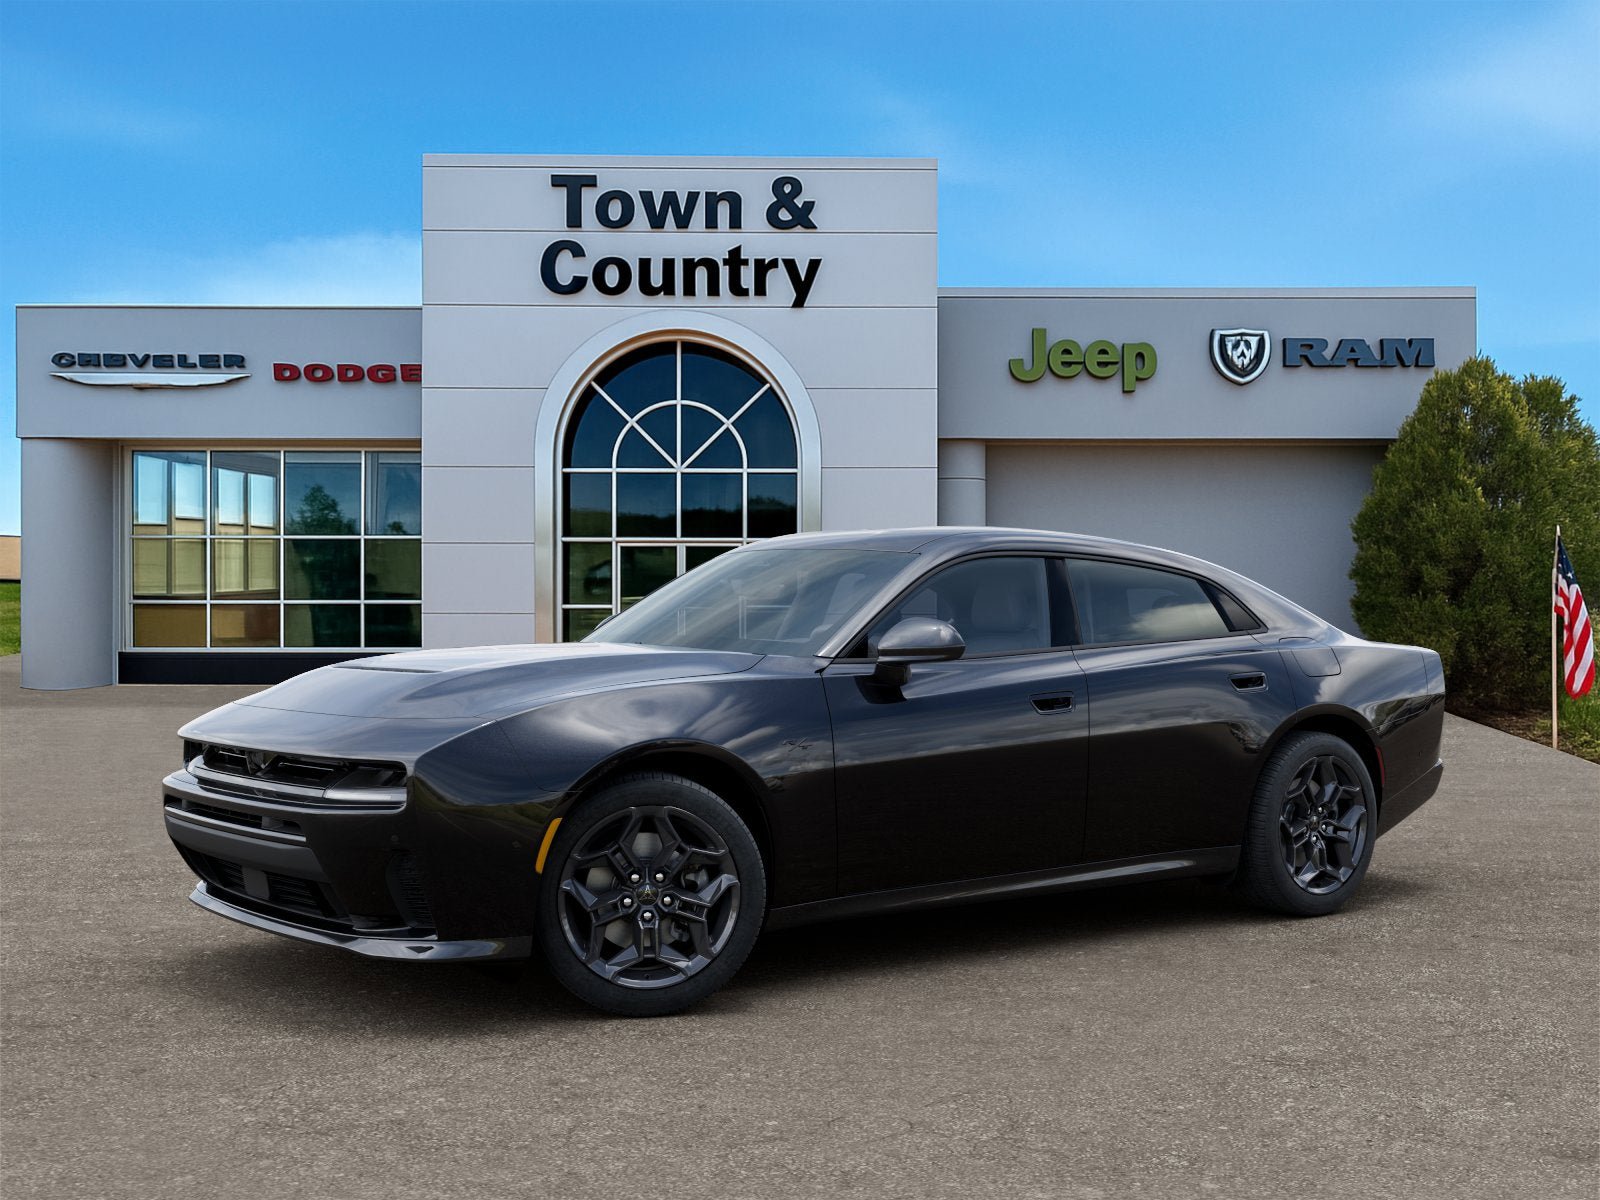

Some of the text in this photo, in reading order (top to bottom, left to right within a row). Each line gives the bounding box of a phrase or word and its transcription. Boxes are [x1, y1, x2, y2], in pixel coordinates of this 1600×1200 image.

[551, 174, 818, 230] Town &
[540, 239, 822, 308] Country
[273, 362, 422, 383] DODGE
[1009, 327, 1157, 393] Jeep
[1283, 337, 1435, 369] RAM
